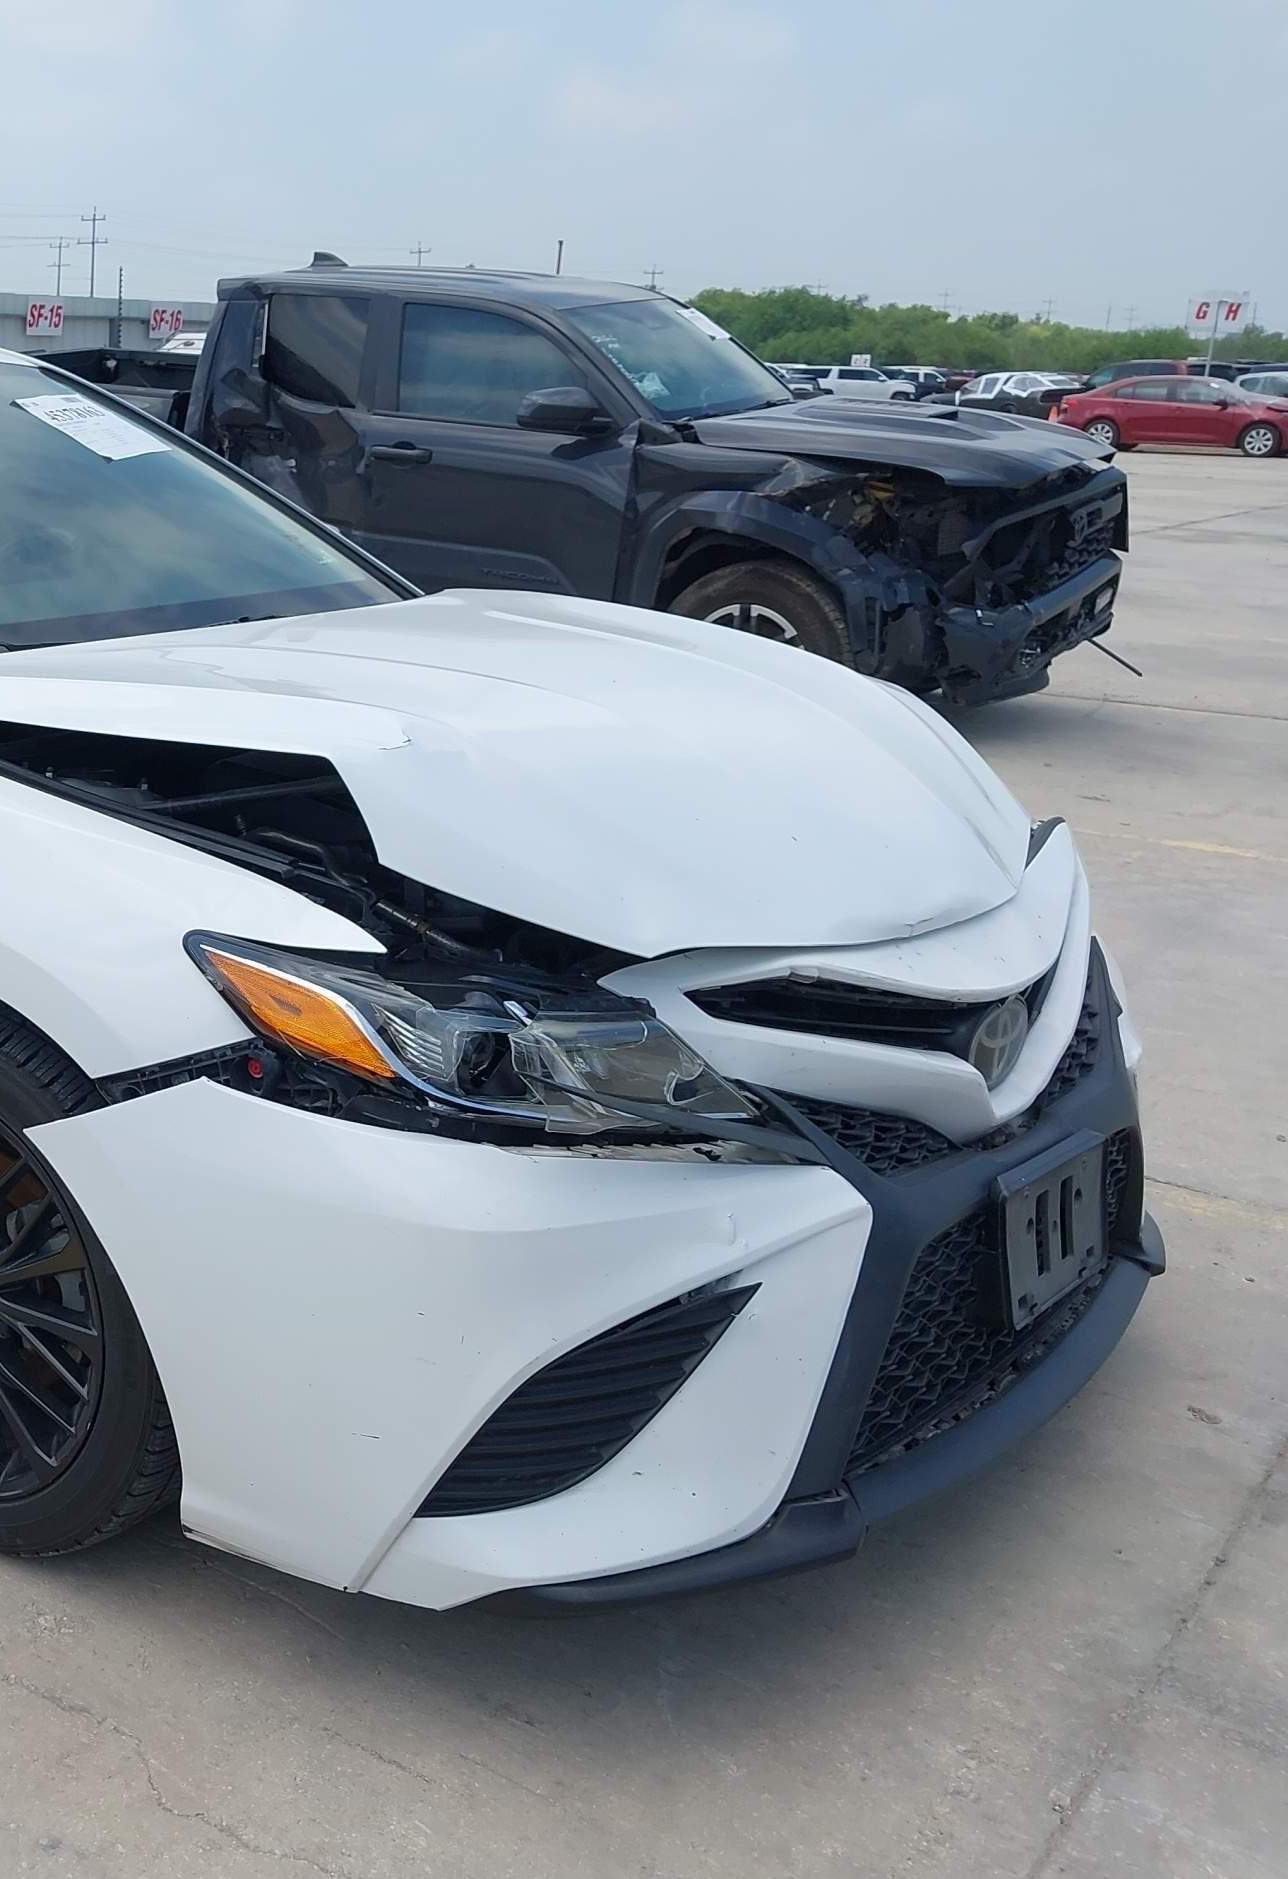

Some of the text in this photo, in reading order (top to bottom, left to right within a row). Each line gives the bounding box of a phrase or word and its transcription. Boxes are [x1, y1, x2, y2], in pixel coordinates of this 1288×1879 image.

[28, 303, 63, 329] SF-15
[152, 308, 183, 332] SF-16
[1195, 301, 1211, 320] G
[1224, 302, 1242, 321] H
